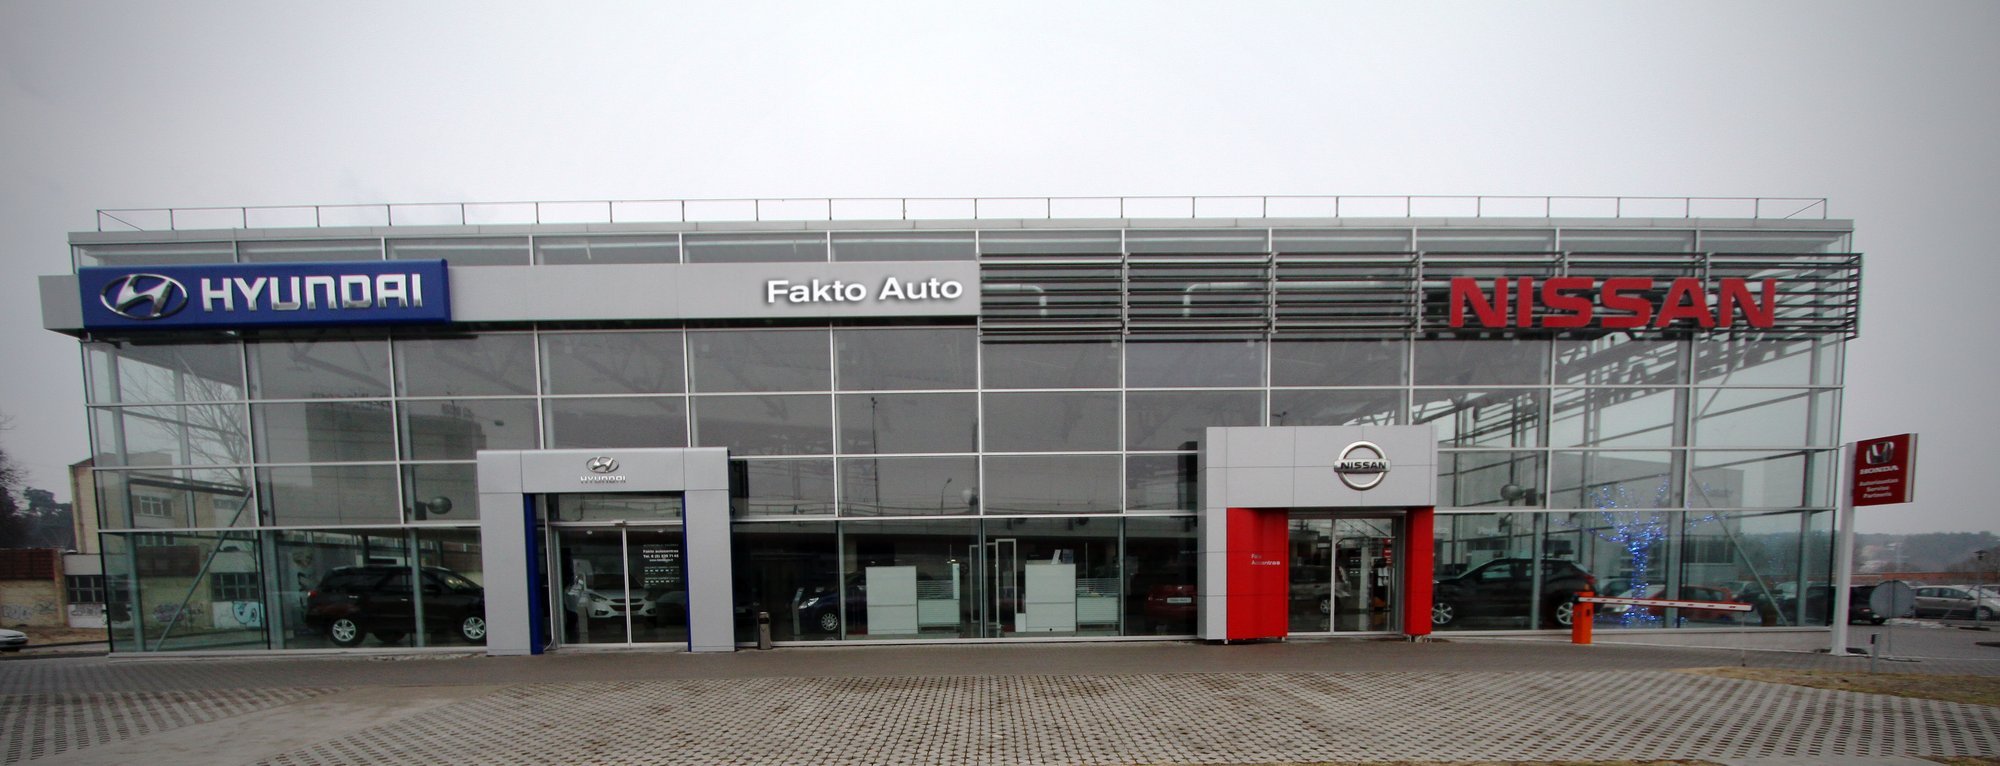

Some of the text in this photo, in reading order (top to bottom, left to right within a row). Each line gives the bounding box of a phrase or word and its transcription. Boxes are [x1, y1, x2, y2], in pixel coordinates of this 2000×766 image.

[201, 273, 423, 312] HYUNDAI
[767, 277, 963, 303] Fakto Auto
[1450, 276, 1776, 328] NISSAN
[1340, 461, 1387, 470] NISSAN
[1859, 465, 1899, 475] HONDA
[580, 475, 626, 483] HYUNDAI
